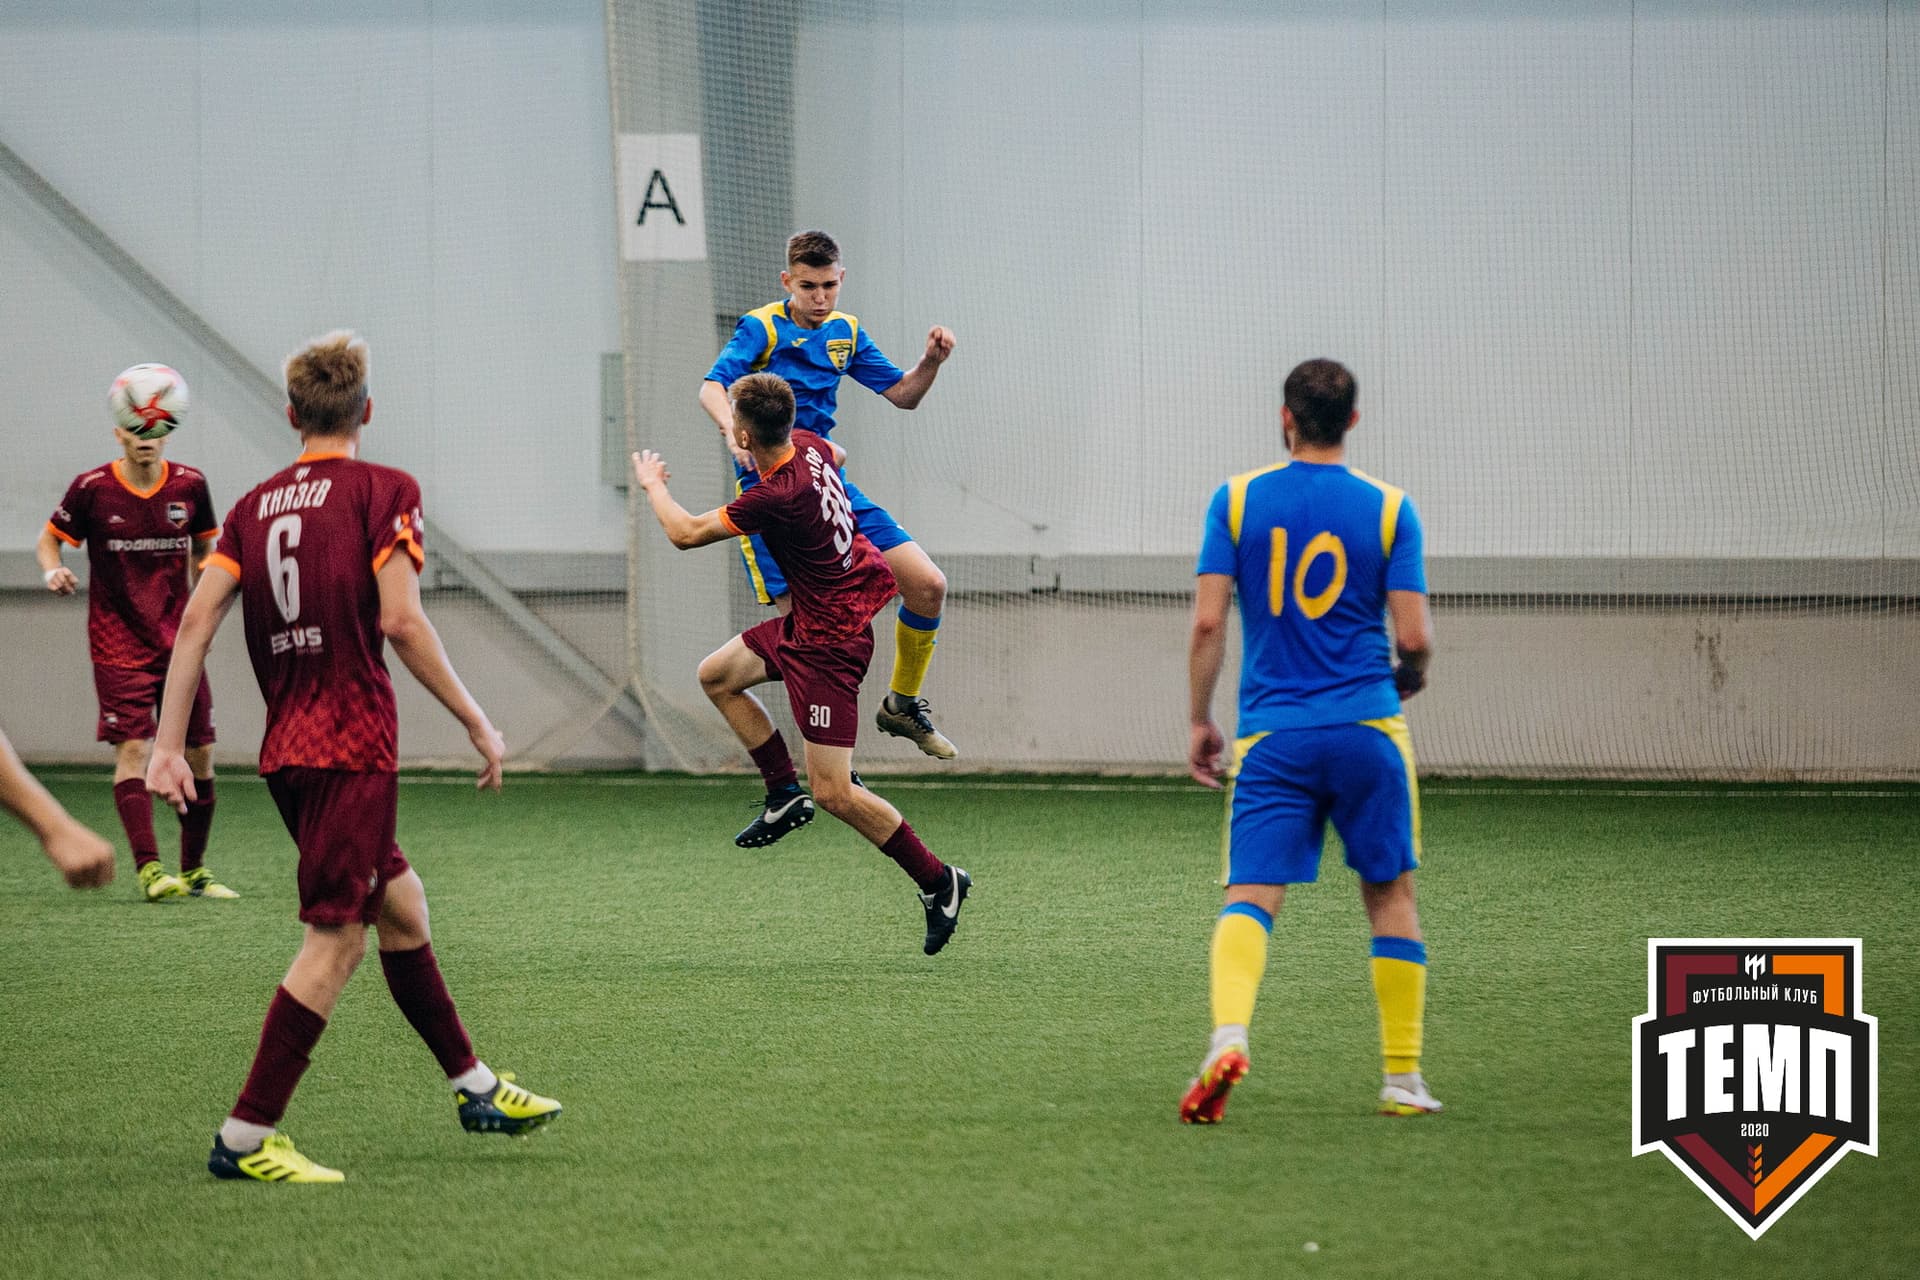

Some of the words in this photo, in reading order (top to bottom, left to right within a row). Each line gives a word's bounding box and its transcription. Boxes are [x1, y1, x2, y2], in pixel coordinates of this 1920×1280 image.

[267, 513, 303, 624] 6
[1268, 526, 1348, 620] 10
[809, 704, 831, 728] 30
